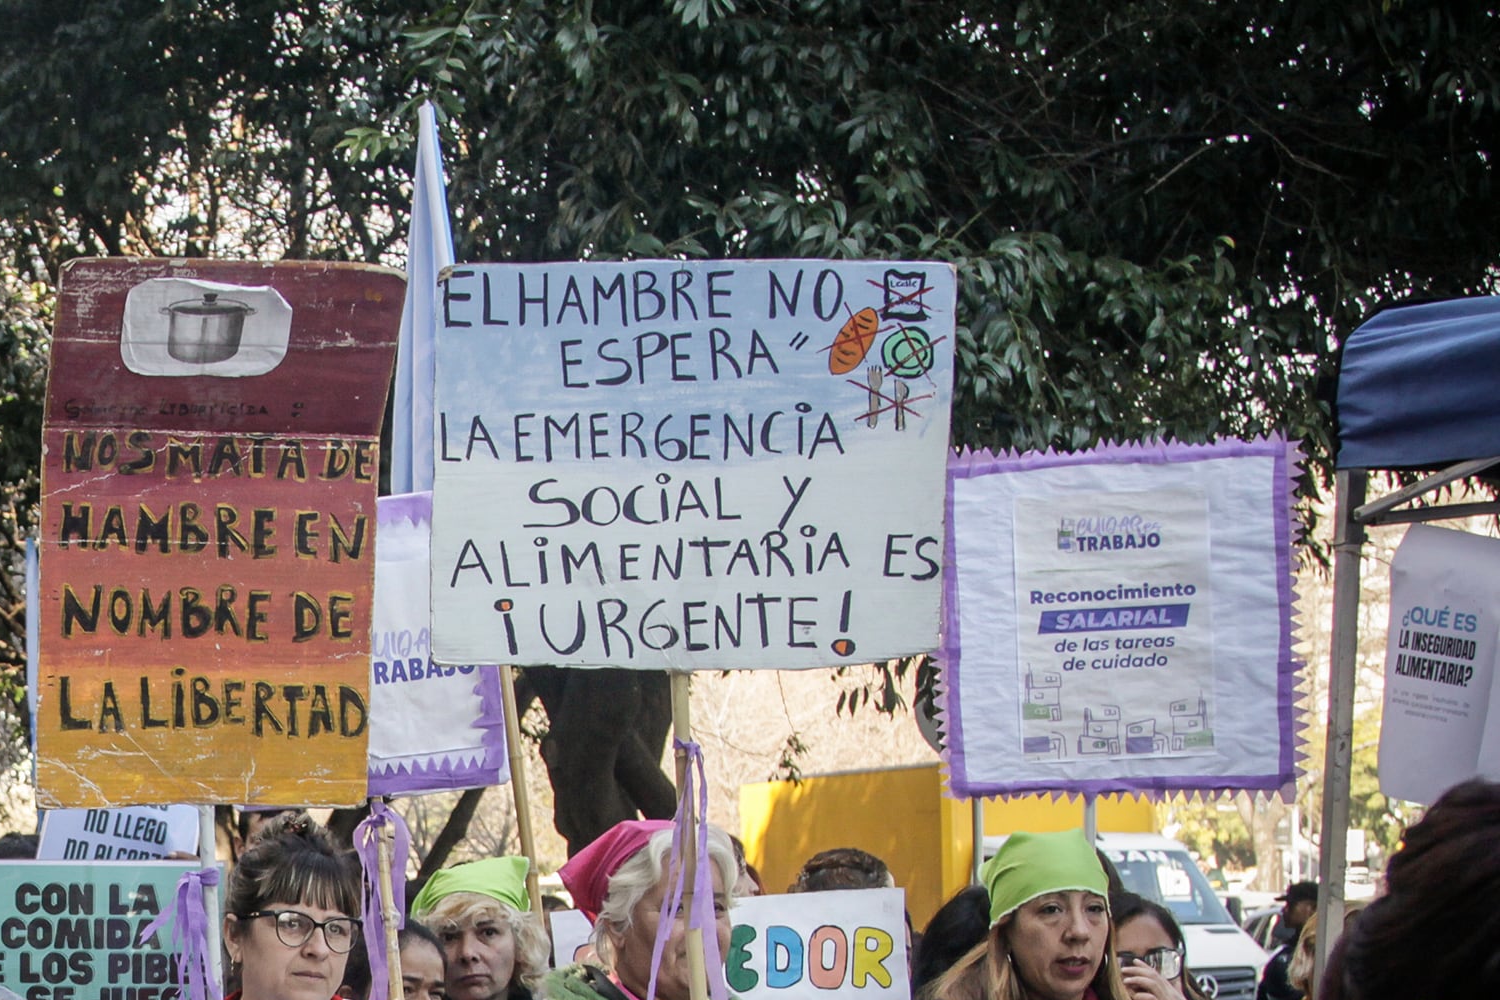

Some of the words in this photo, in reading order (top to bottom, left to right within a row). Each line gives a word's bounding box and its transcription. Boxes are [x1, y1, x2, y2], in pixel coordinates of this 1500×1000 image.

[437, 270, 509, 328] EL
[518, 269, 735, 326] HAMBRE
[768, 268, 844, 322] NO
[440, 411, 499, 463] LA
[61, 430, 158, 476] NOS
[165, 435, 309, 484] MATA
[317, 439, 378, 484] DE
[777, 475, 812, 530] Y
[57, 501, 278, 560] HAMBRE
[294, 509, 370, 564] EN
[1076, 533, 1161, 552] TRABAJO
[883, 533, 940, 582] ES
[1029, 583, 1197, 605] Reconocimiento
[60, 583, 272, 643] NOMBRE
[291, 589, 355, 643] DE
[493, 590, 856, 658] ¡URGENTE!
[1055, 607, 1173, 631] SALARIAL
[1402, 605, 1451, 628] ¿QUÉ
[1453, 613, 1478, 633] ES
[372, 627, 430, 659] UIDA
[1054, 639, 1079, 654] de
[1083, 637, 1109, 652] las
[1115, 635, 1176, 651] tareas
[1398, 629, 1410, 650] LA
[1411, 631, 1477, 662] INSEGURIDAD
[1063, 657, 1087, 671] de
[1090, 653, 1169, 671] cuidado
[1395, 653, 1474, 688] ALIMENTARIA?
[57, 676, 125, 734] LA
[84, 809, 110, 835] NO
[113, 811, 168, 846] LLEGO
[14, 882, 95, 916] CON
[108, 883, 161, 916] LA
[0, 917, 161, 951] COMIDA
[19, 952, 95, 985] LOS
[107, 952, 203, 985] PIBE
[725, 923, 895, 994] EDOR
